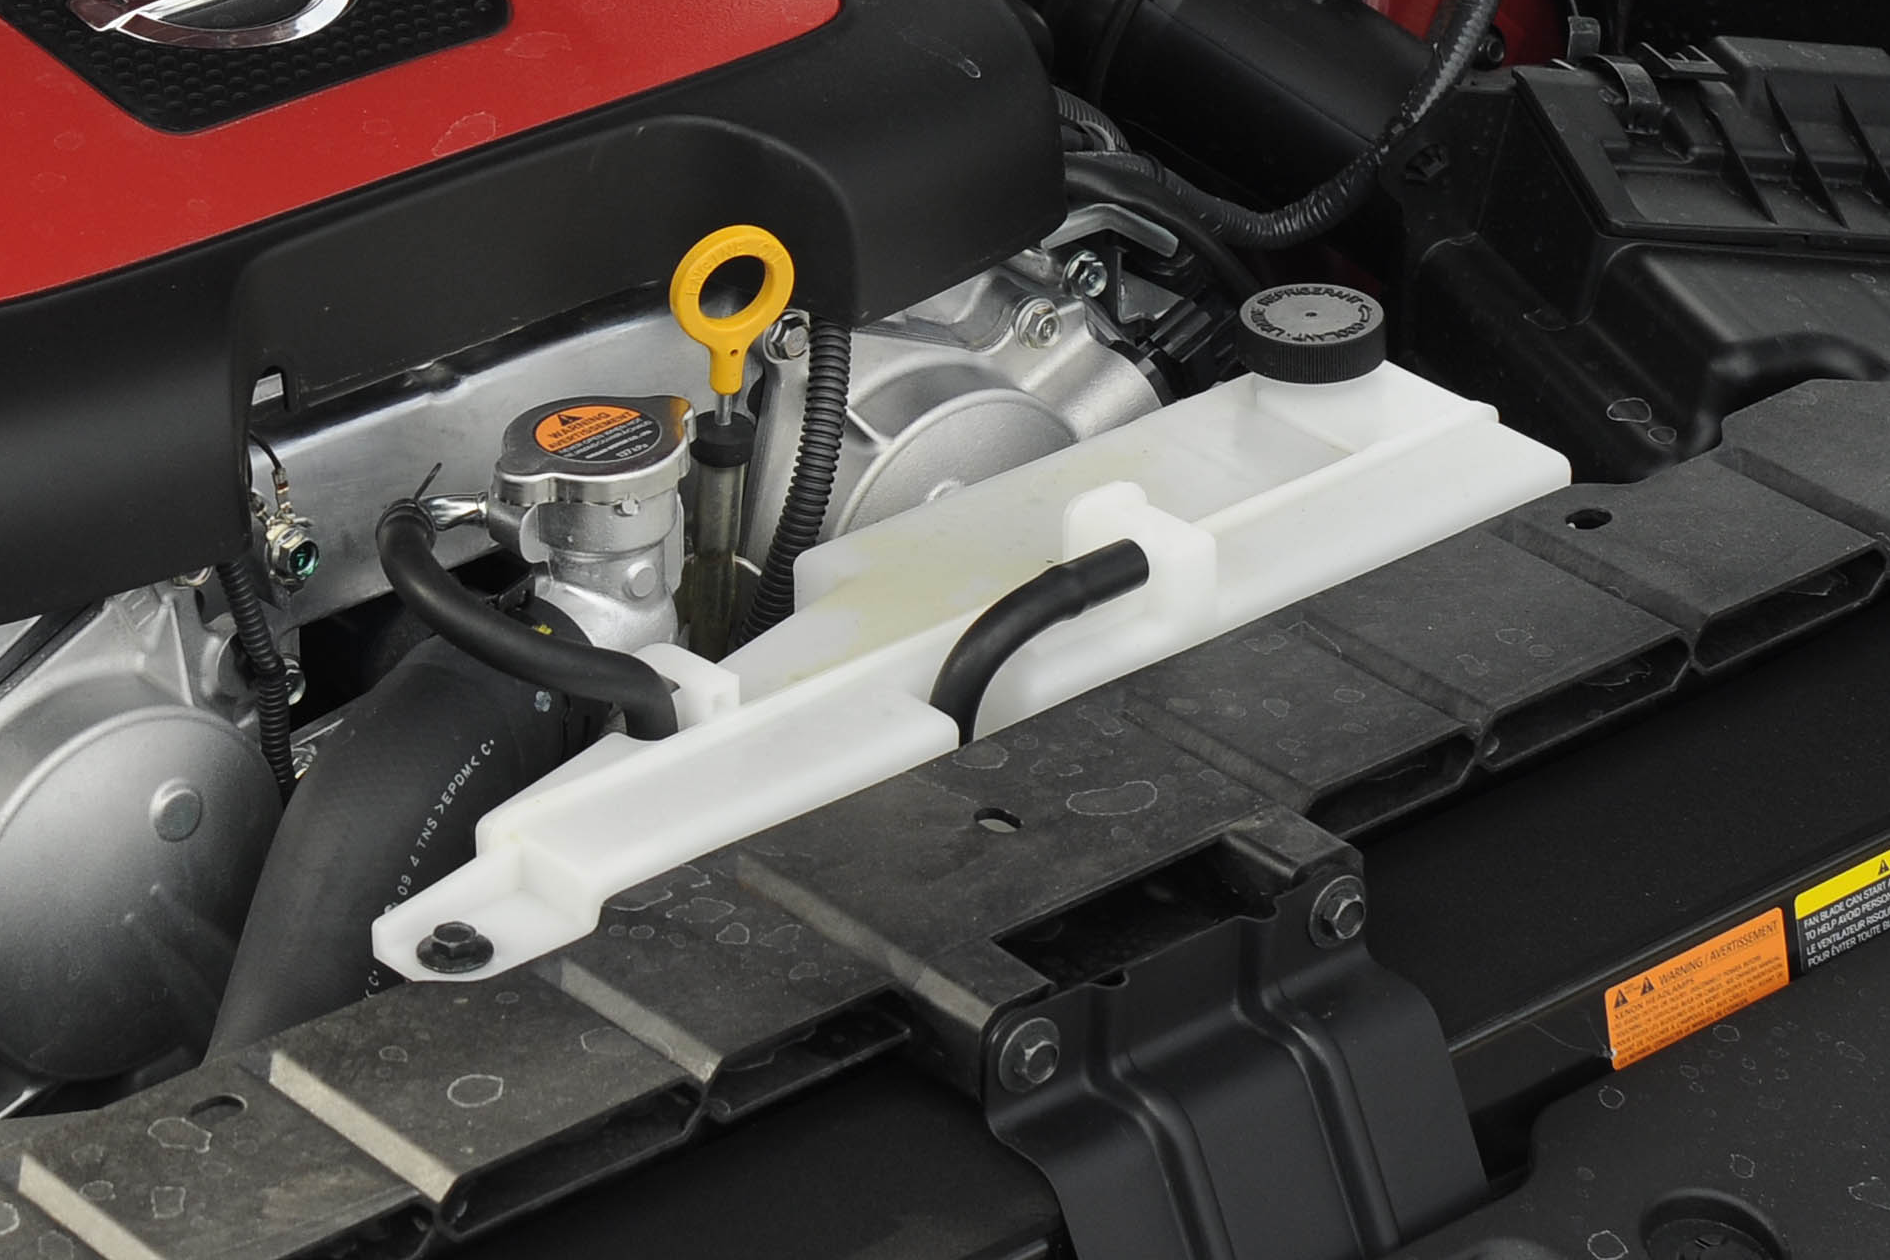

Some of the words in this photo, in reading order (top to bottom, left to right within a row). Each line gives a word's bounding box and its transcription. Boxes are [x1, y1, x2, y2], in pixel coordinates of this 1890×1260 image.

[548, 411, 611, 440] WARNING
[416, 816, 439, 850] TNS
[1803, 914, 1820, 930] FAN
[1819, 900, 1845, 922] BLADE
[1845, 891, 1864, 909] CAN
[1863, 880, 1887, 901] START
[1804, 928, 1817, 942] TO
[1817, 918, 1838, 936] HELP
[1806, 942, 1817, 956] LE
[1807, 949, 1831, 968] POUR
[1857, 924, 1882, 943] TOUTE
[1658, 955, 1704, 986] WARNING
